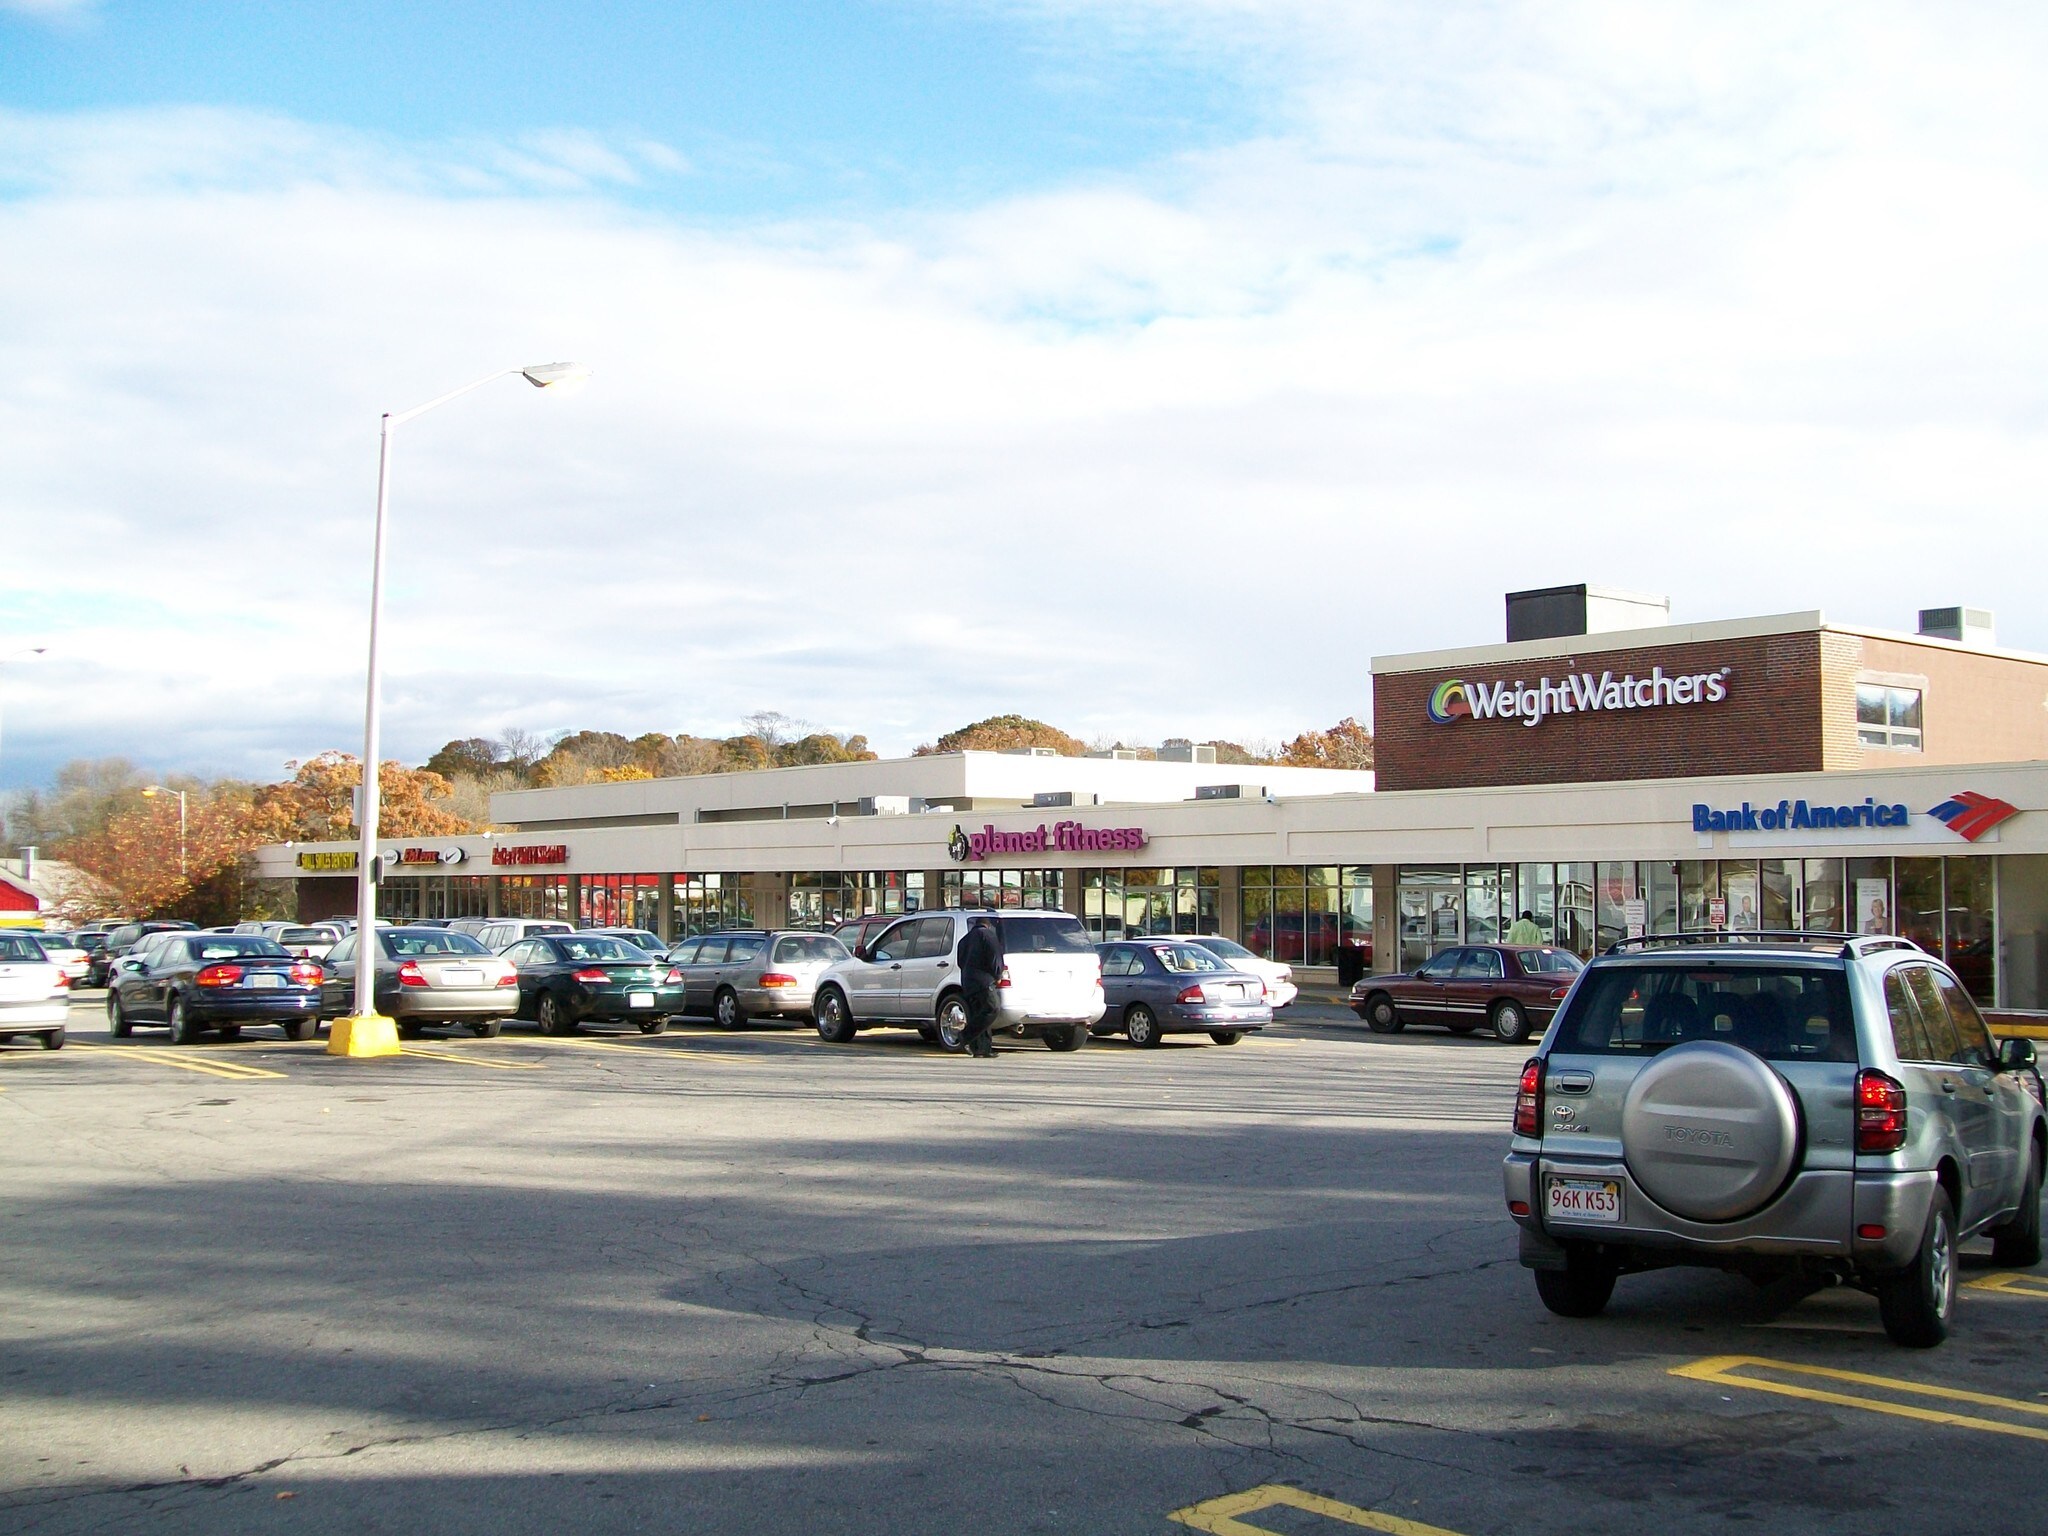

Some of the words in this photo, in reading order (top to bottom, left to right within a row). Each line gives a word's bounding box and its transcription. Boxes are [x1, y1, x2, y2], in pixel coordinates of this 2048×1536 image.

[1692, 802, 1760, 832] Bank
[1761, 800, 1790, 830] of
[1791, 797, 1909, 829] America
[970, 824, 1048, 861] planet
[1053, 821, 1143, 851] fitness
[1552, 1123, 1589, 1133] RAV4
[1664, 1125, 1734, 1148] TOYOTA
[1552, 1189, 1581, 1209] 96K
[1585, 1191, 1615, 1211] K53
